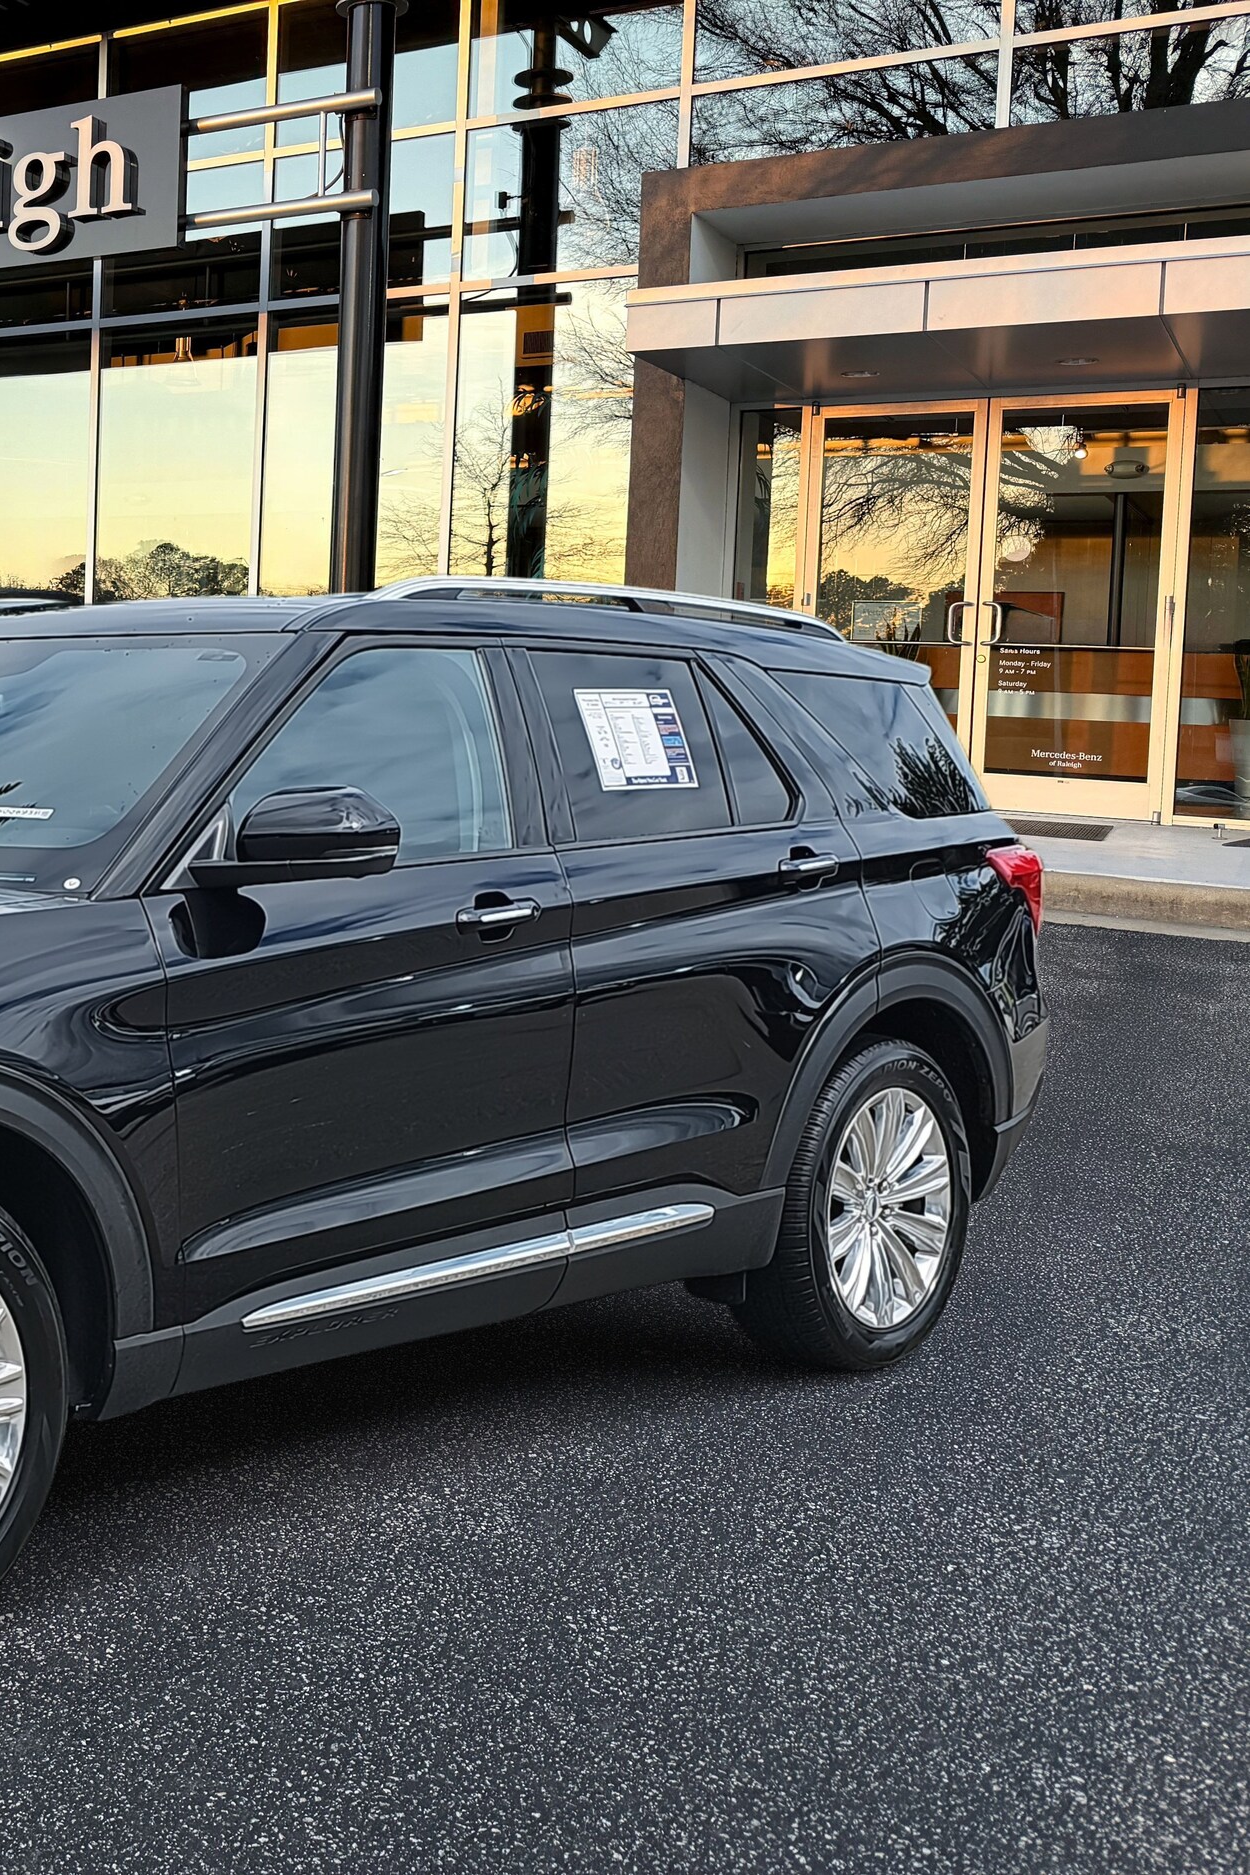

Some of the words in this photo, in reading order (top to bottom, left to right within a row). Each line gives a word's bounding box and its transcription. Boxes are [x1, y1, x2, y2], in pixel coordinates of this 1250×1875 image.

[999, 660, 1025, 668] Monday
[1030, 660, 1051, 669] Friday
[997, 680, 1027, 688] Saturday
[1031, 749, 1102, 761] Mercedes-Benz
[1057, 760, 1082, 769] Raleigh
